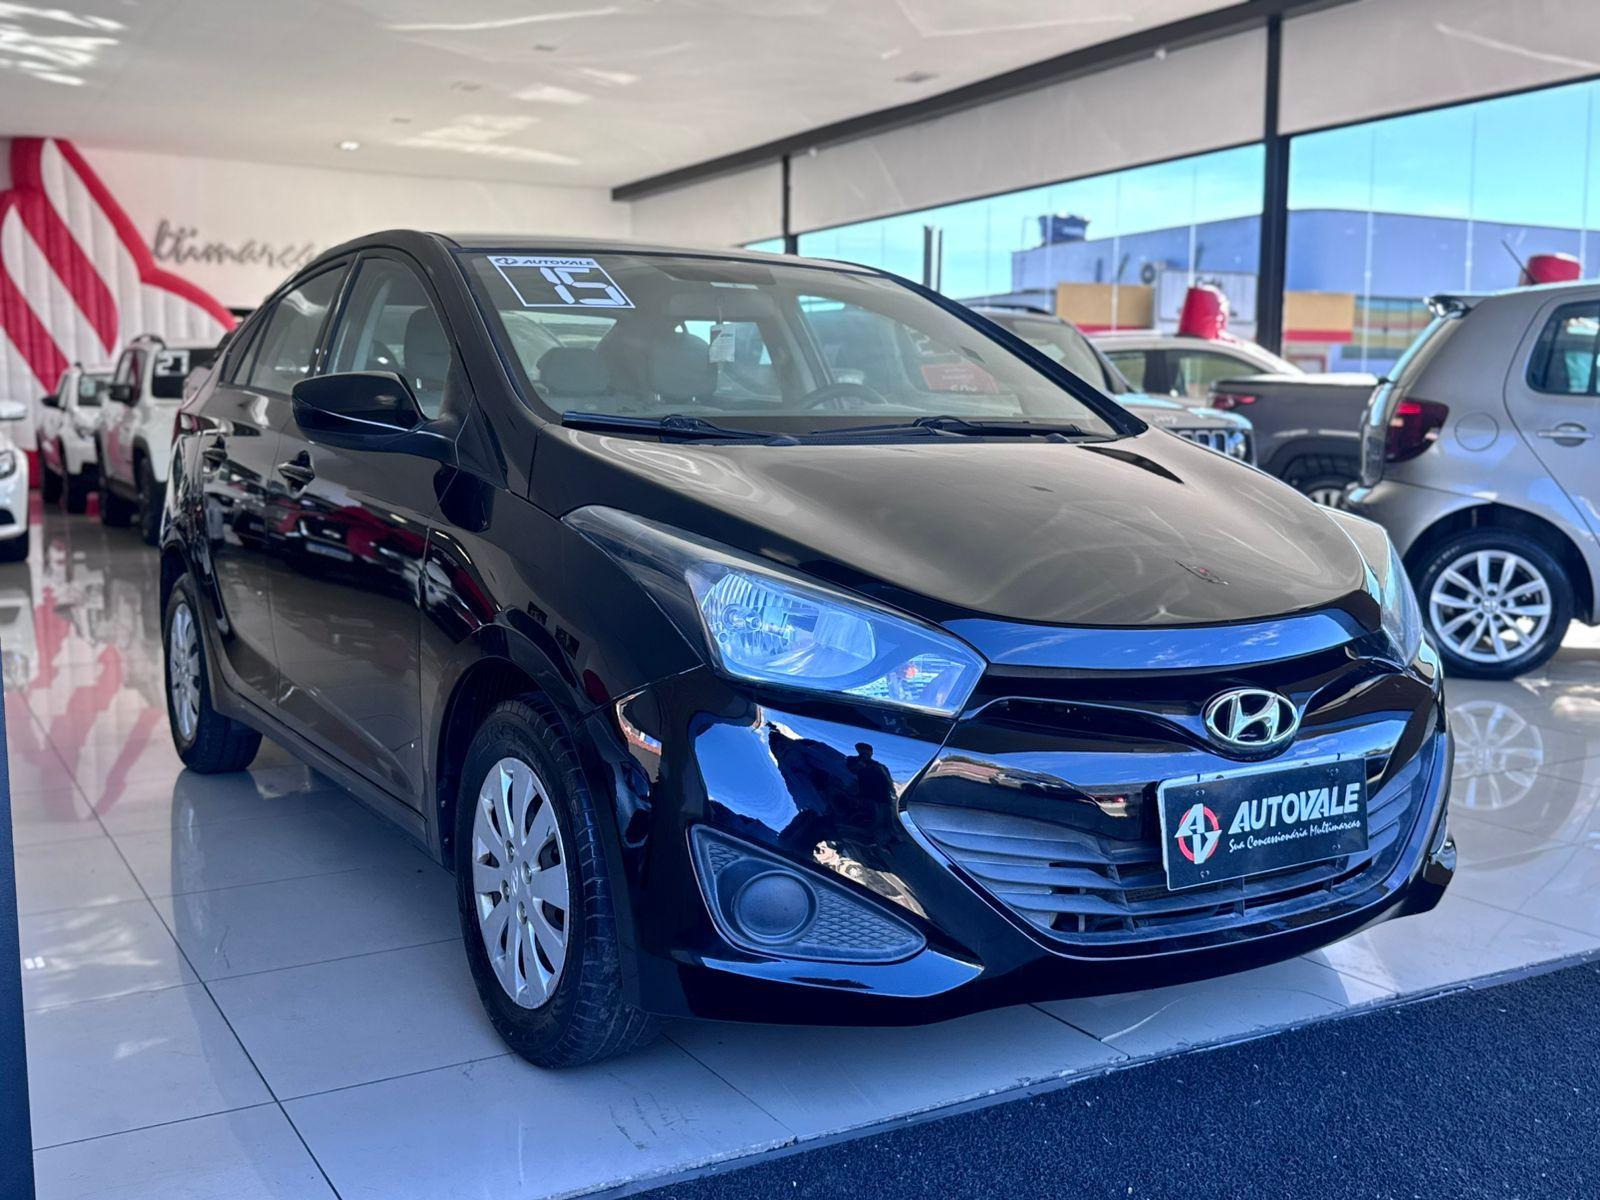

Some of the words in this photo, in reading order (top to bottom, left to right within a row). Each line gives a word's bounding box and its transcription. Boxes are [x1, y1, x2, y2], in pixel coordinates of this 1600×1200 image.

[540, 267, 627, 305] 15
[1228, 783, 1360, 834] AUTOVALE
[1229, 838, 1245, 853] Sua
[1309, 820, 1361, 837] Multimarcas
